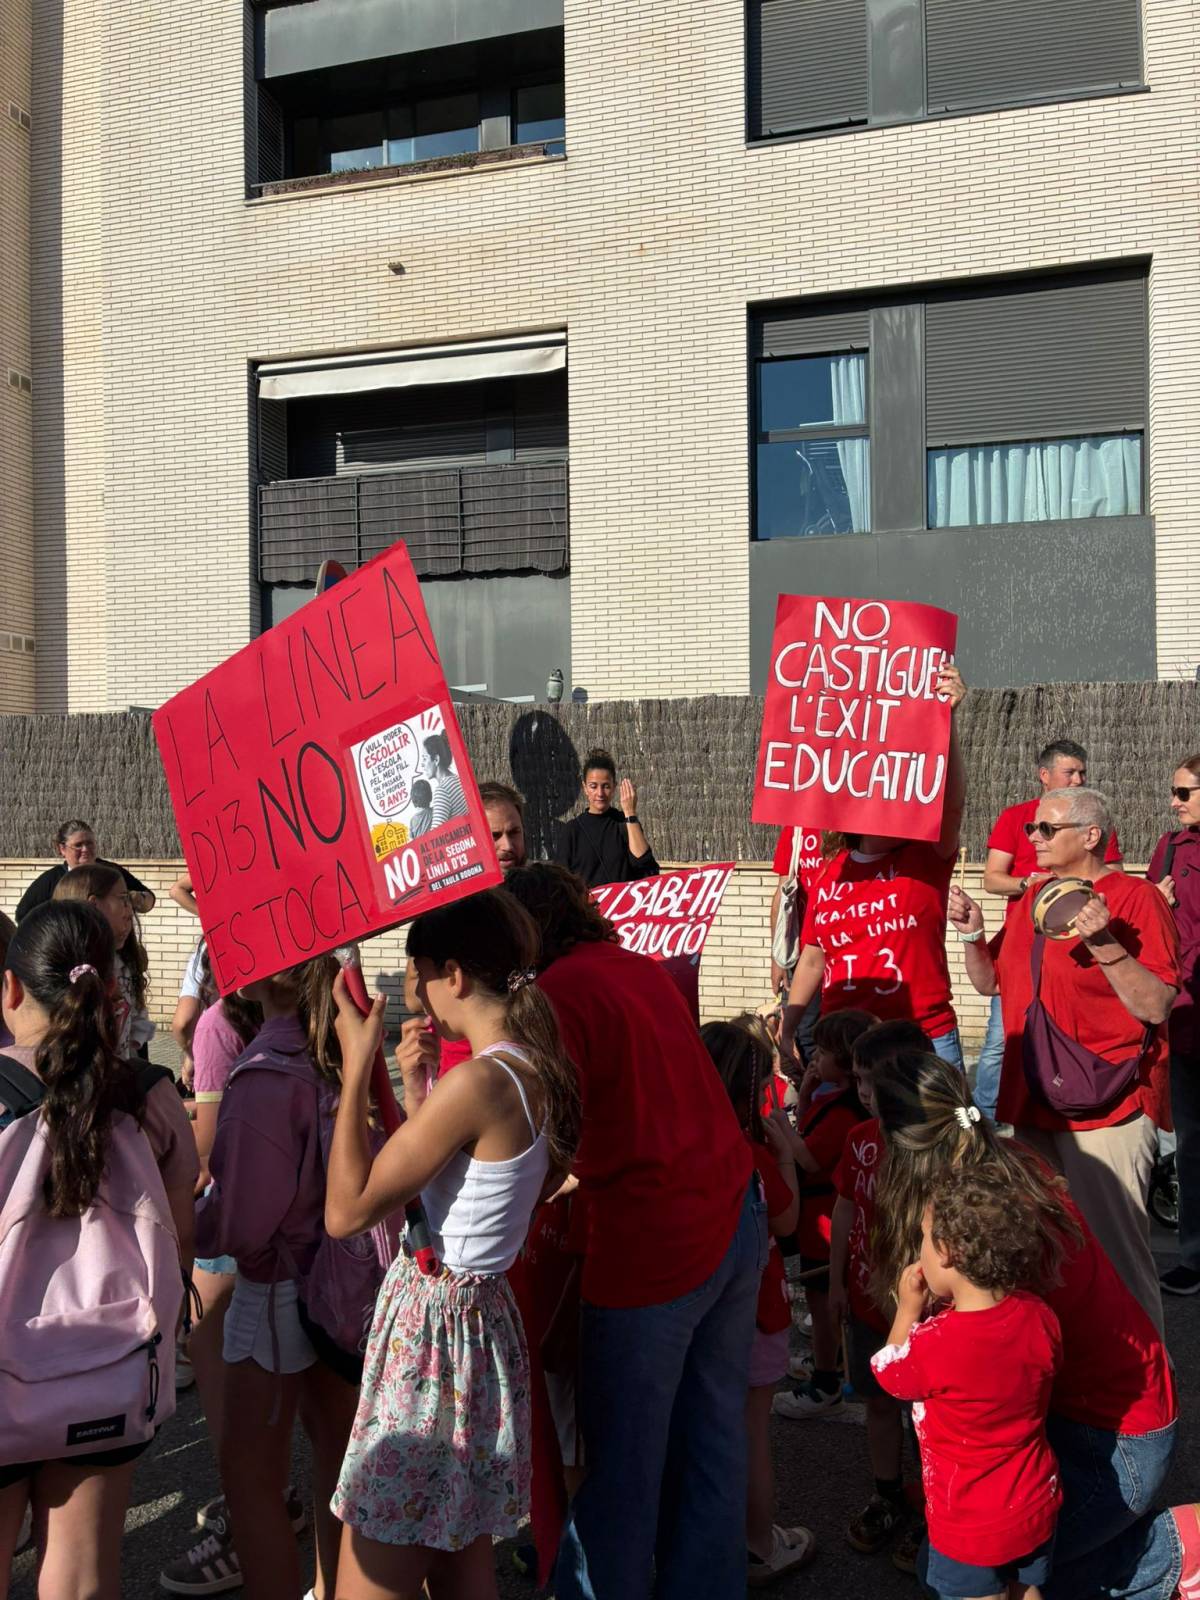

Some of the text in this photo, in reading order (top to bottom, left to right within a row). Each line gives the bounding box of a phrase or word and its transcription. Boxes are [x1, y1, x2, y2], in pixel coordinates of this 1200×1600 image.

[814, 601, 891, 641] NO
[168, 567, 439, 807] LA LINEA
[364, 733, 411, 769] ESCOLLIR
[366, 727, 403, 754] VULL PODER
[372, 753, 402, 777] L'ESCOLA
[382, 768, 395, 779] MEU
[396, 761, 409, 772] FILL
[763, 741, 945, 804] EDUCATIU
[257, 741, 347, 870] NO
[379, 788, 409, 811] 9 ANYS
[445, 836, 477, 857] SEGONA
[383, 847, 420, 900] NO
[426, 861, 451, 880] LÍNIA
[204, 859, 369, 990] ES TOCA
